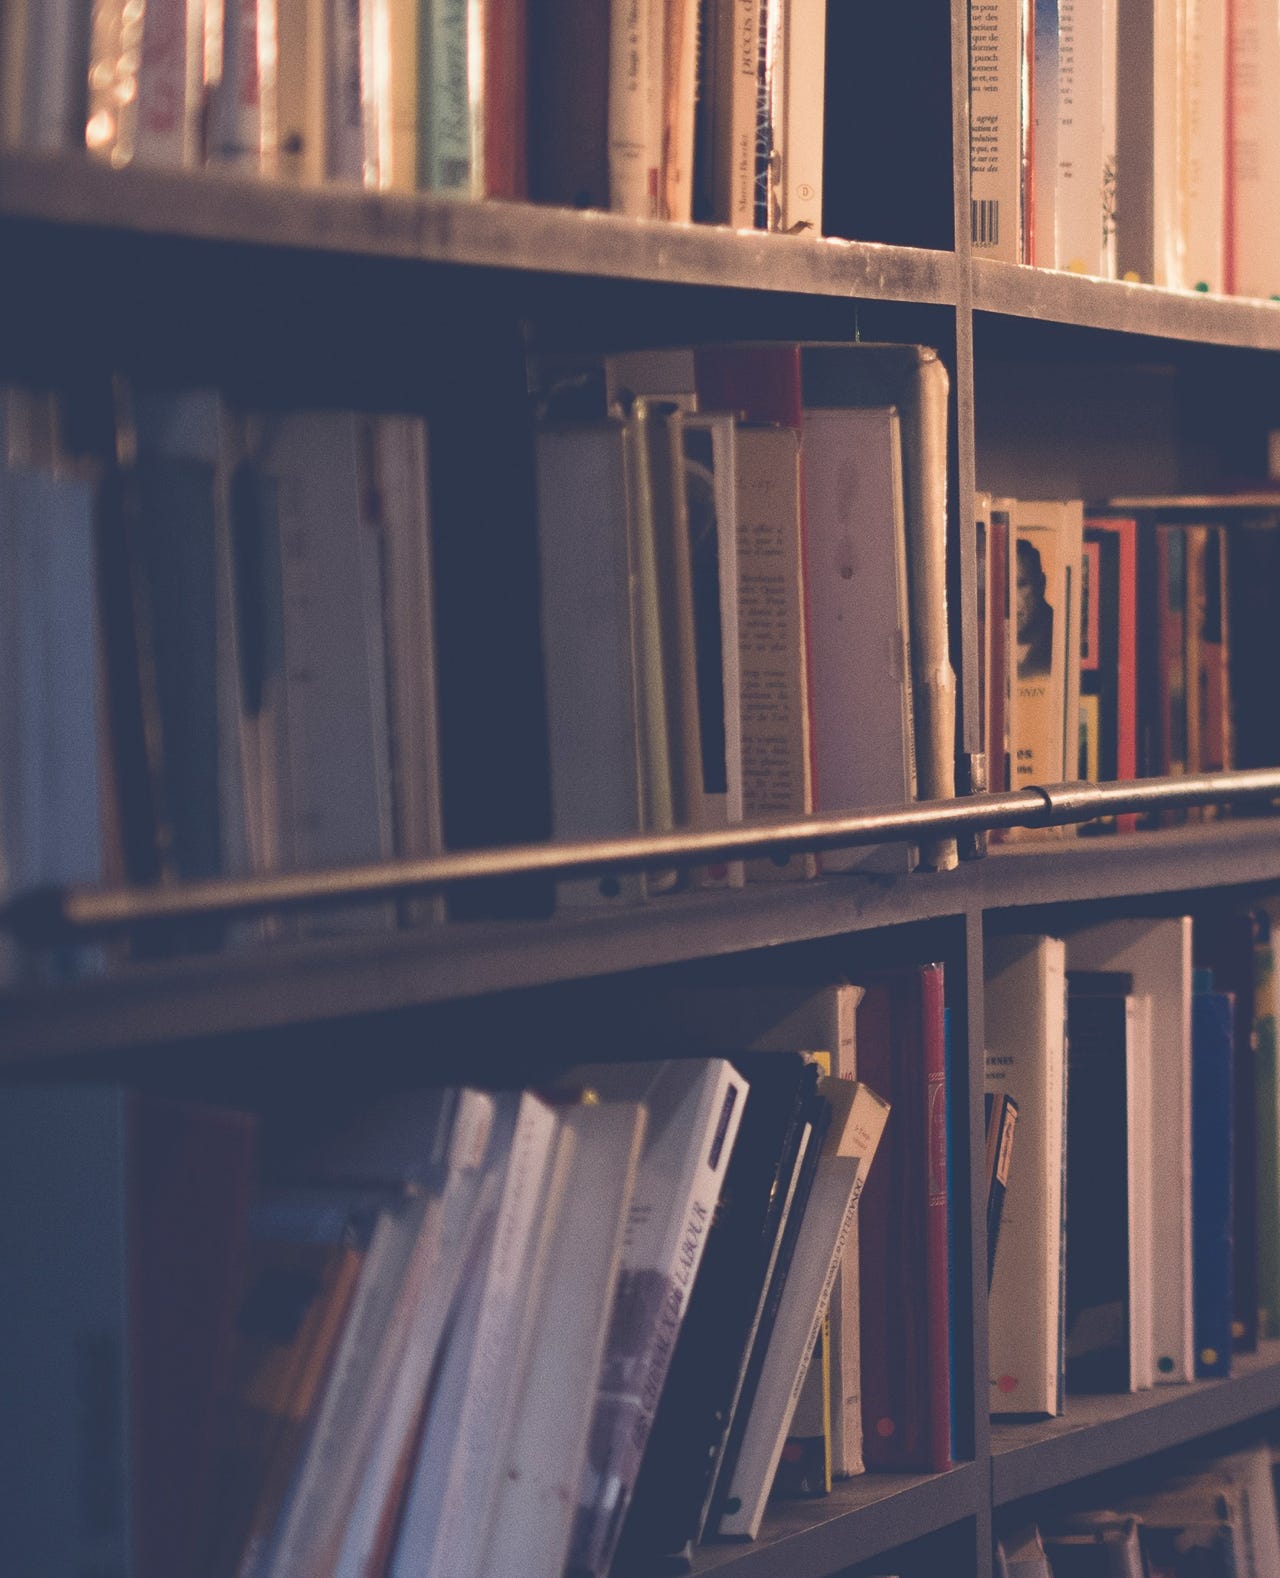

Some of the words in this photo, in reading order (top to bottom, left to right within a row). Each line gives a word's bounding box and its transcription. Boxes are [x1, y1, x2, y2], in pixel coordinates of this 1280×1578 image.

[741, 18, 754, 75] précis
[975, 53, 998, 62] punch
[677, 1201, 708, 1286] LABOUR
